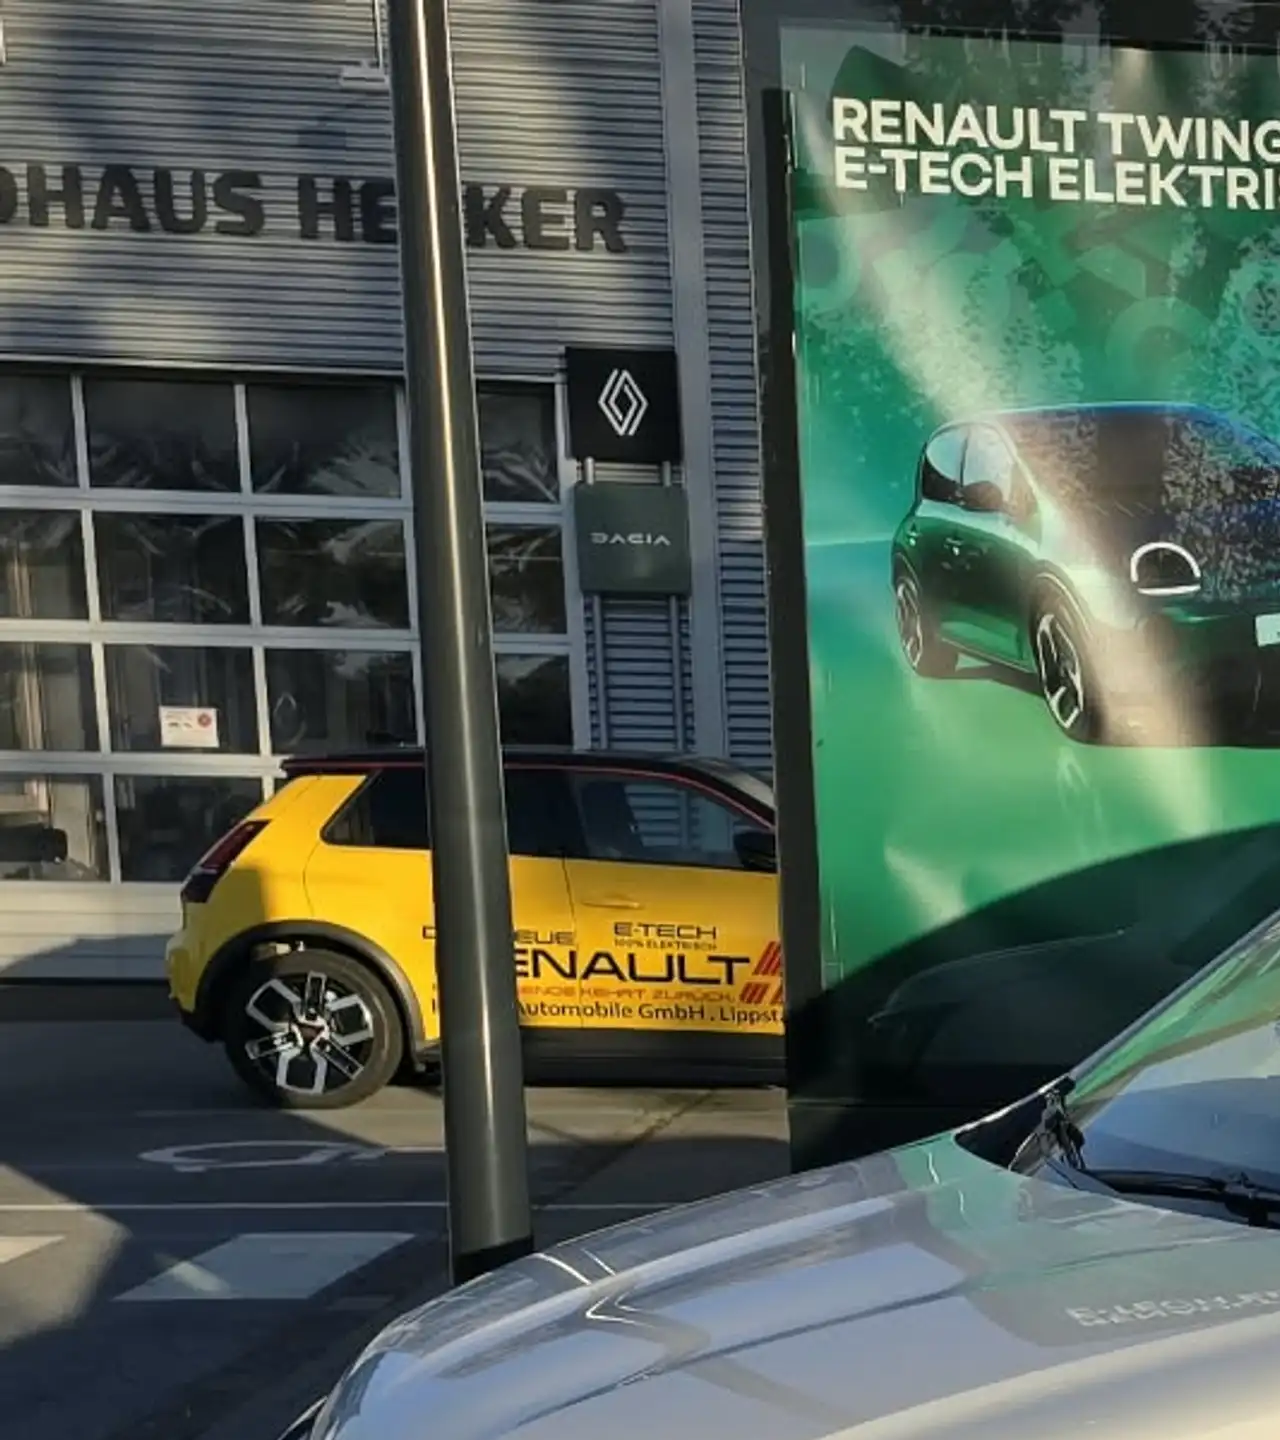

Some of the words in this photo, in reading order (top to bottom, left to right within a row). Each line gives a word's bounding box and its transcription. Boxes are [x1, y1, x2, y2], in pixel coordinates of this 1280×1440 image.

[833, 97, 1087, 152] RENAULT
[835, 146, 1033, 198] E-TECH
[298, 174, 627, 253] HEKER
[590, 532, 671, 546] DACIA
[514, 930, 575, 946] EUE
[614, 922, 718, 940] E-TECH
[515, 948, 750, 985] NAULT
[638, 1004, 704, 1020] GmbH
